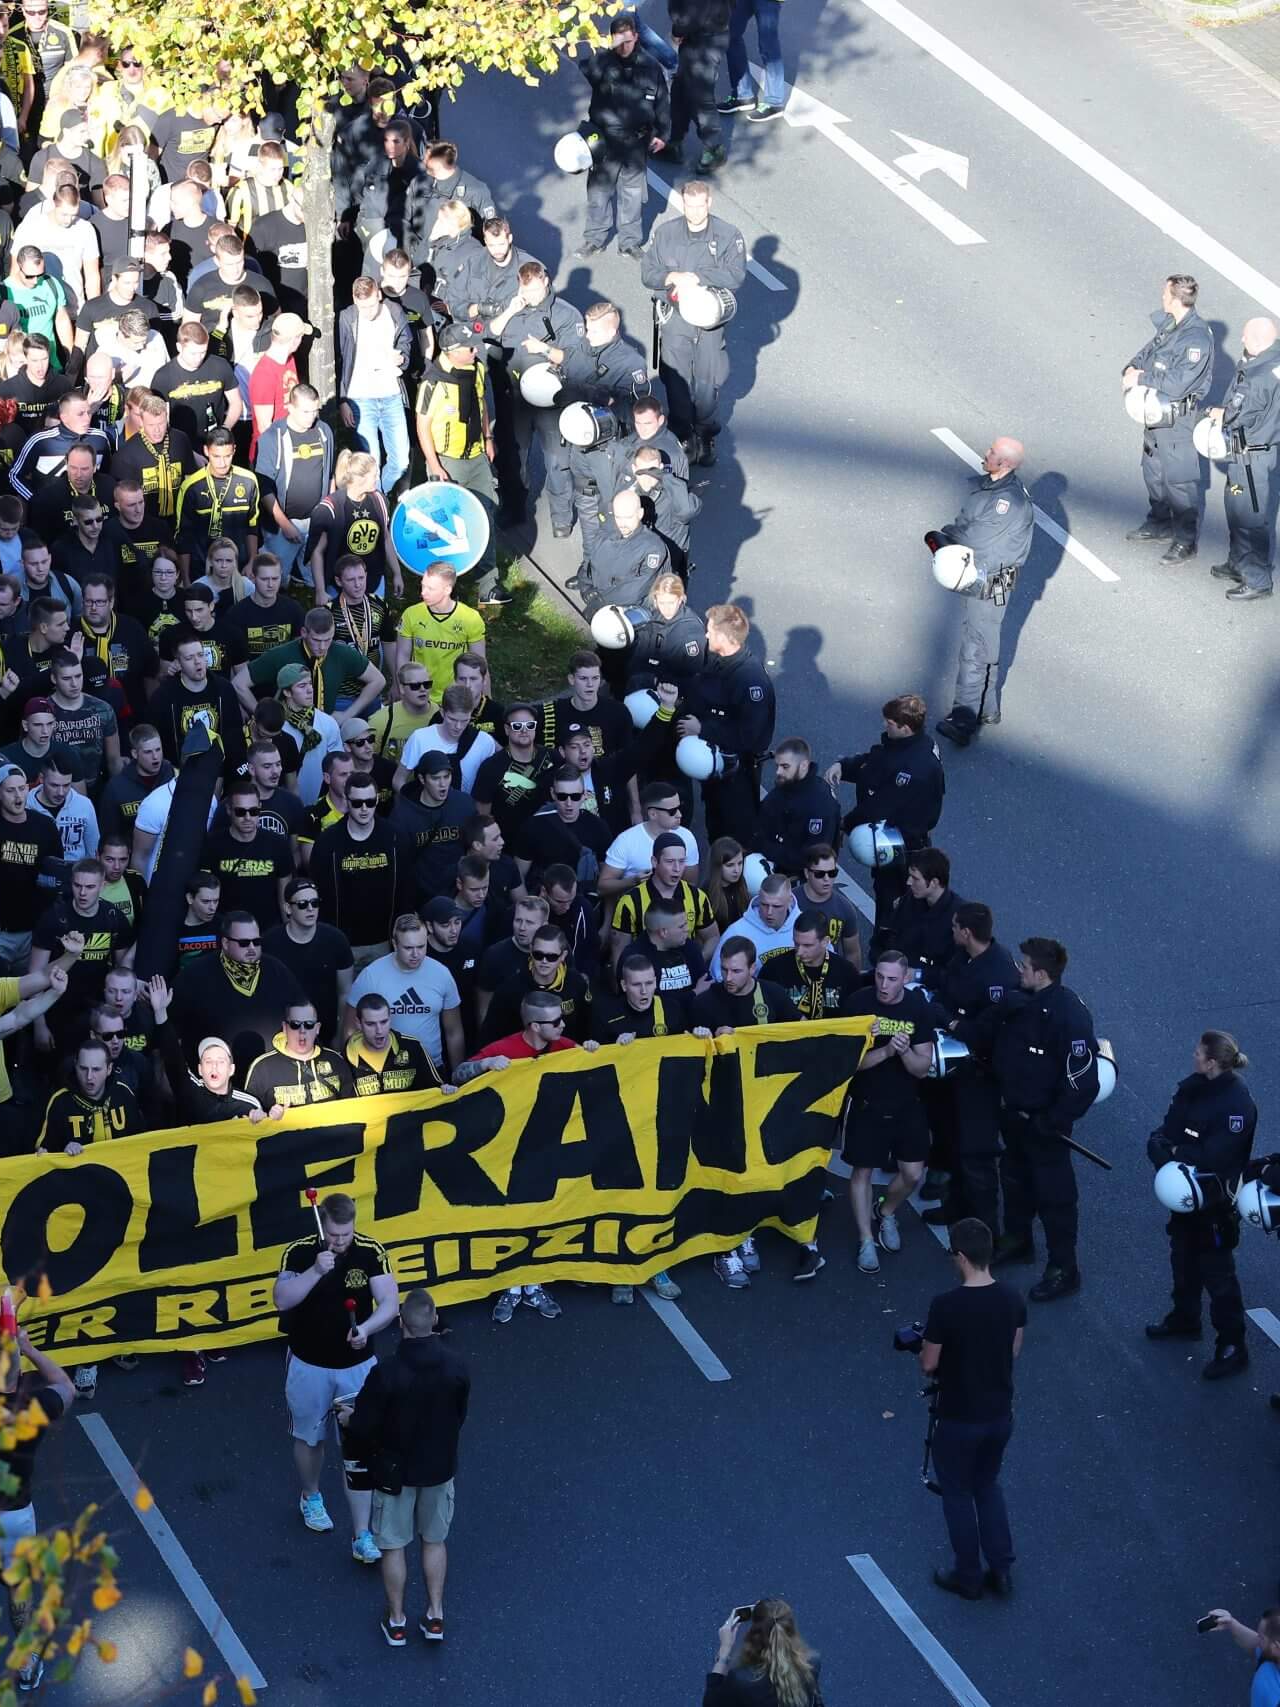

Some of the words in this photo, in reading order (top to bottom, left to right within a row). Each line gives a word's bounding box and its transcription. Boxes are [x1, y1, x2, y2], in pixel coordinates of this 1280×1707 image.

[352, 523, 378, 544] BVB
[179, 941, 217, 951] LACOSTE
[389, 1004, 431, 1015] adidas
[156, 1277, 280, 1334] RB
[392, 1216, 676, 1282] EIPZIG
